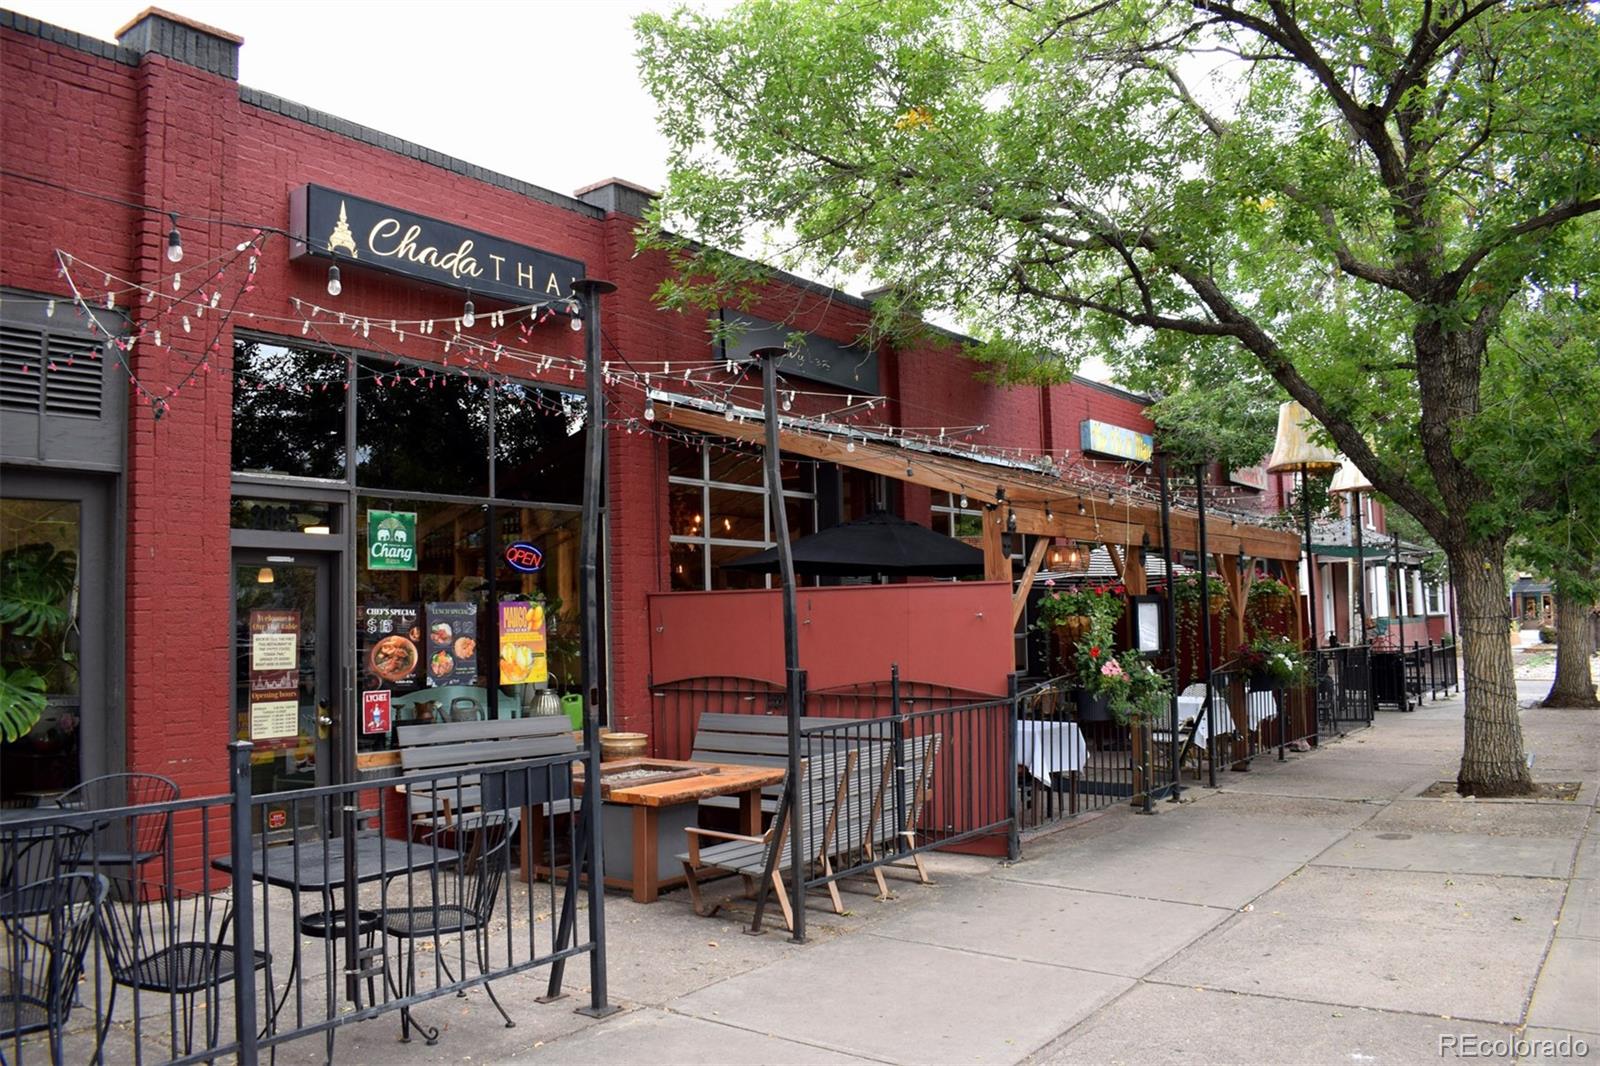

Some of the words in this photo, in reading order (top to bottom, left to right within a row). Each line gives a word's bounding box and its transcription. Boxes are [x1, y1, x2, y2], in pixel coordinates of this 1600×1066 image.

[368, 218, 483, 279] Chada
[371, 542, 413, 562] Chang
[506, 547, 542, 568] OPEN
[390, 608, 416, 616] SPECIAL
[504, 606, 528, 629] MANGO
[252, 691, 279, 700] Opening
[279, 690, 297, 698] hours
